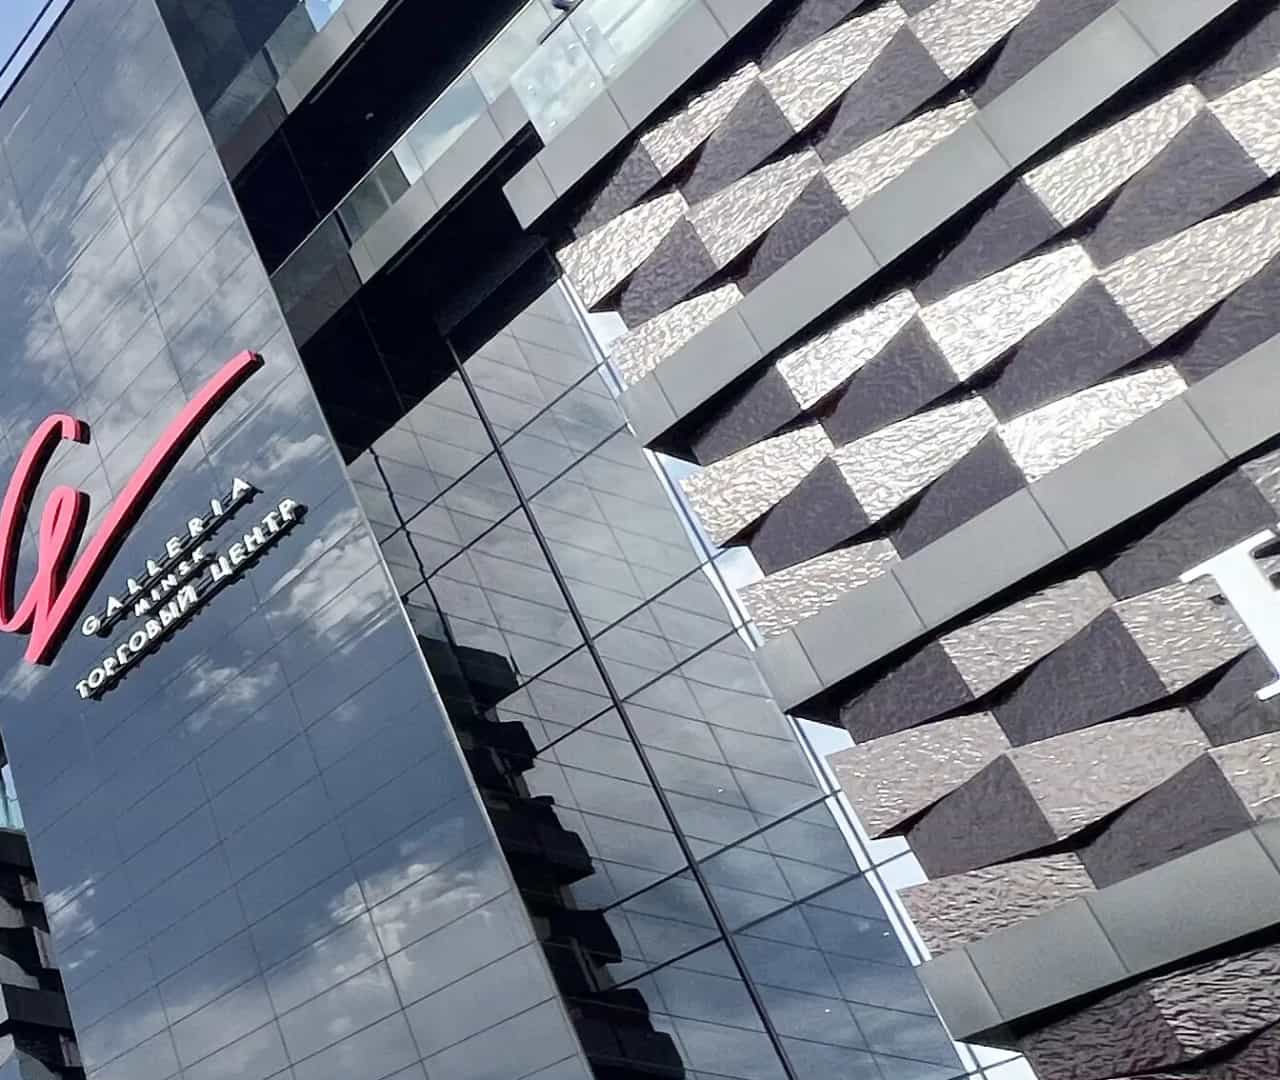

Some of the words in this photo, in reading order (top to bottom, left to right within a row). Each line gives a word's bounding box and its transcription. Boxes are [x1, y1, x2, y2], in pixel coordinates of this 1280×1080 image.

[75, 584, 199, 699] ТОРГОВЫЙ
[209, 497, 298, 582] ЦЕНТР
[80, 477, 252, 636] GALLERIA
[133, 548, 206, 617] MINSK
